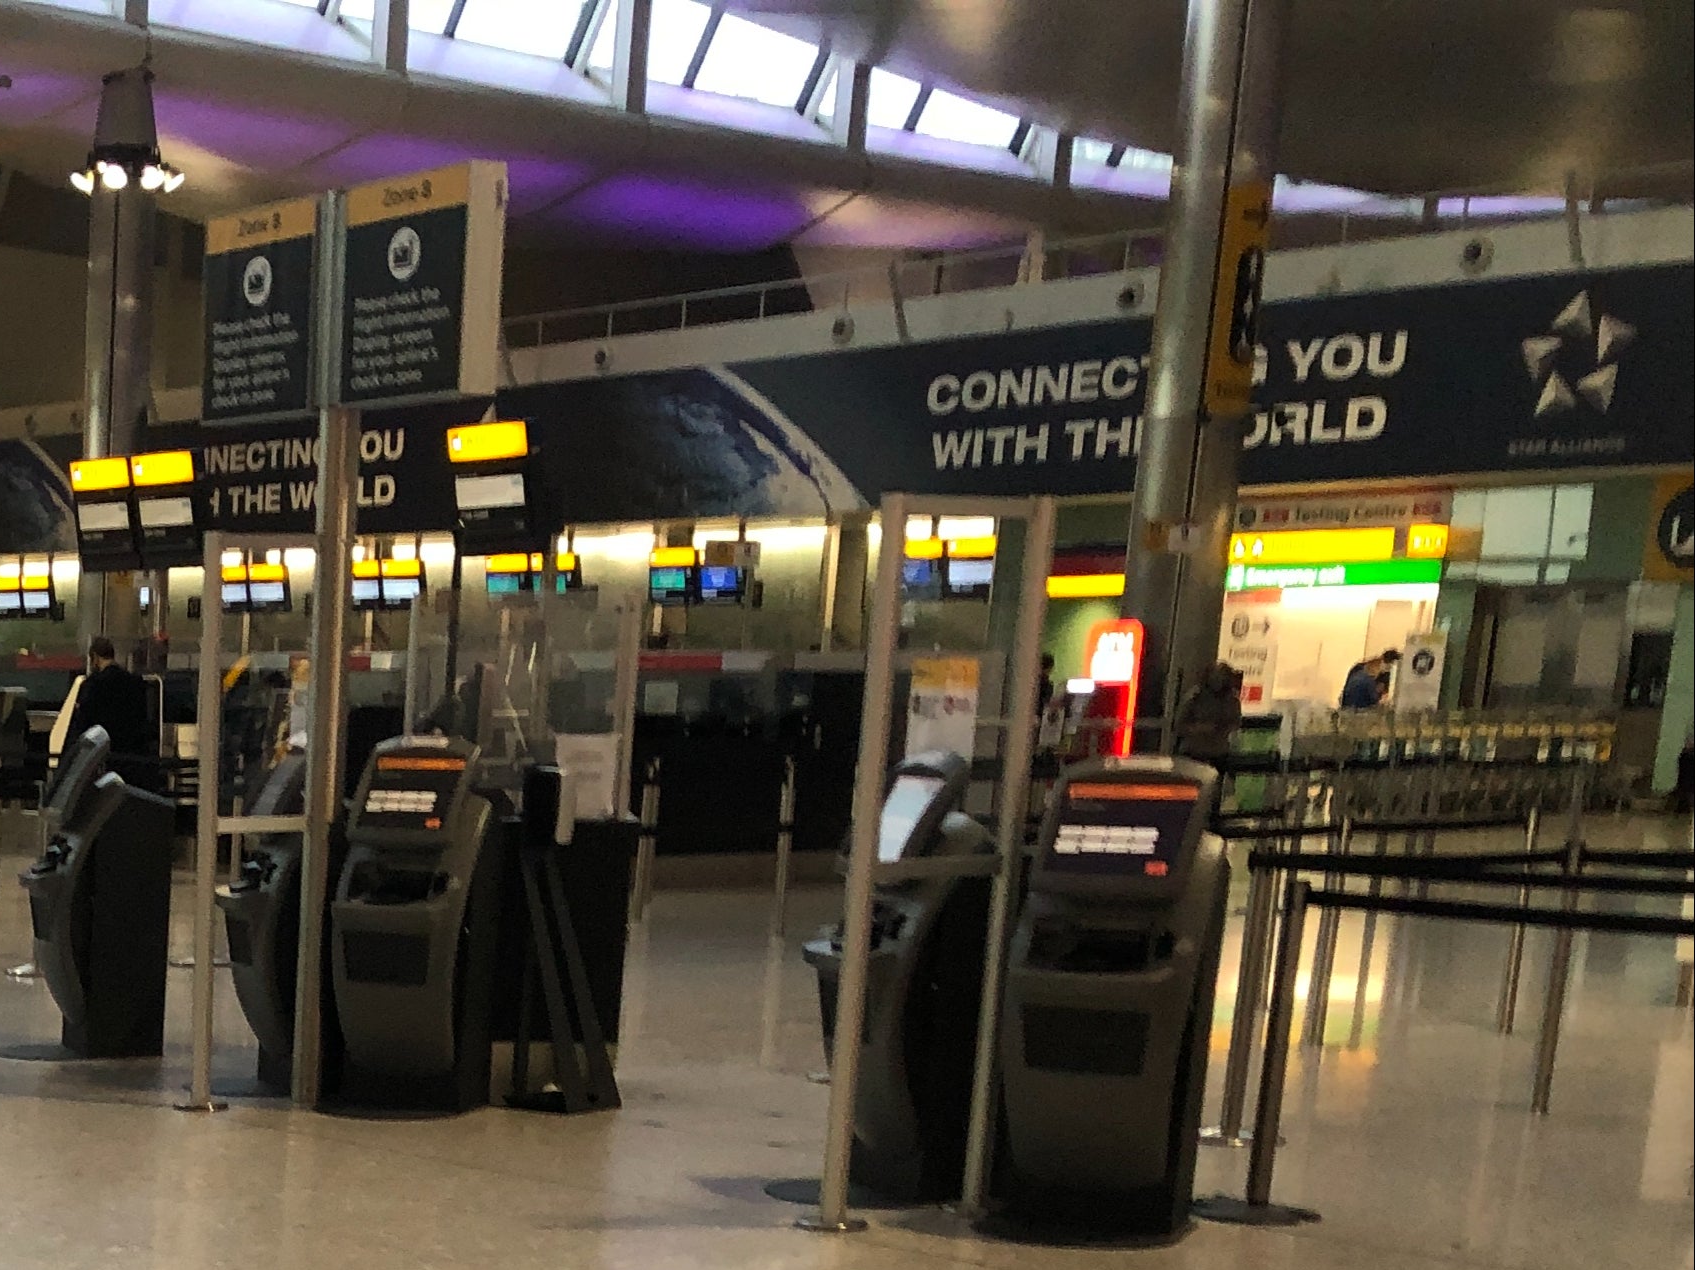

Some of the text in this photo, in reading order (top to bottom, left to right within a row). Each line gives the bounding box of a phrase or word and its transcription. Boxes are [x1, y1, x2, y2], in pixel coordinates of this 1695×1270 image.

[1287, 329, 1411, 385] YOU
[359, 427, 405, 463] OU
[931, 419, 1050, 471] WITH
[227, 482, 282, 517] THE
[1295, 503, 1349, 522] Testing
[1246, 564, 1346, 589] Emergency exit
